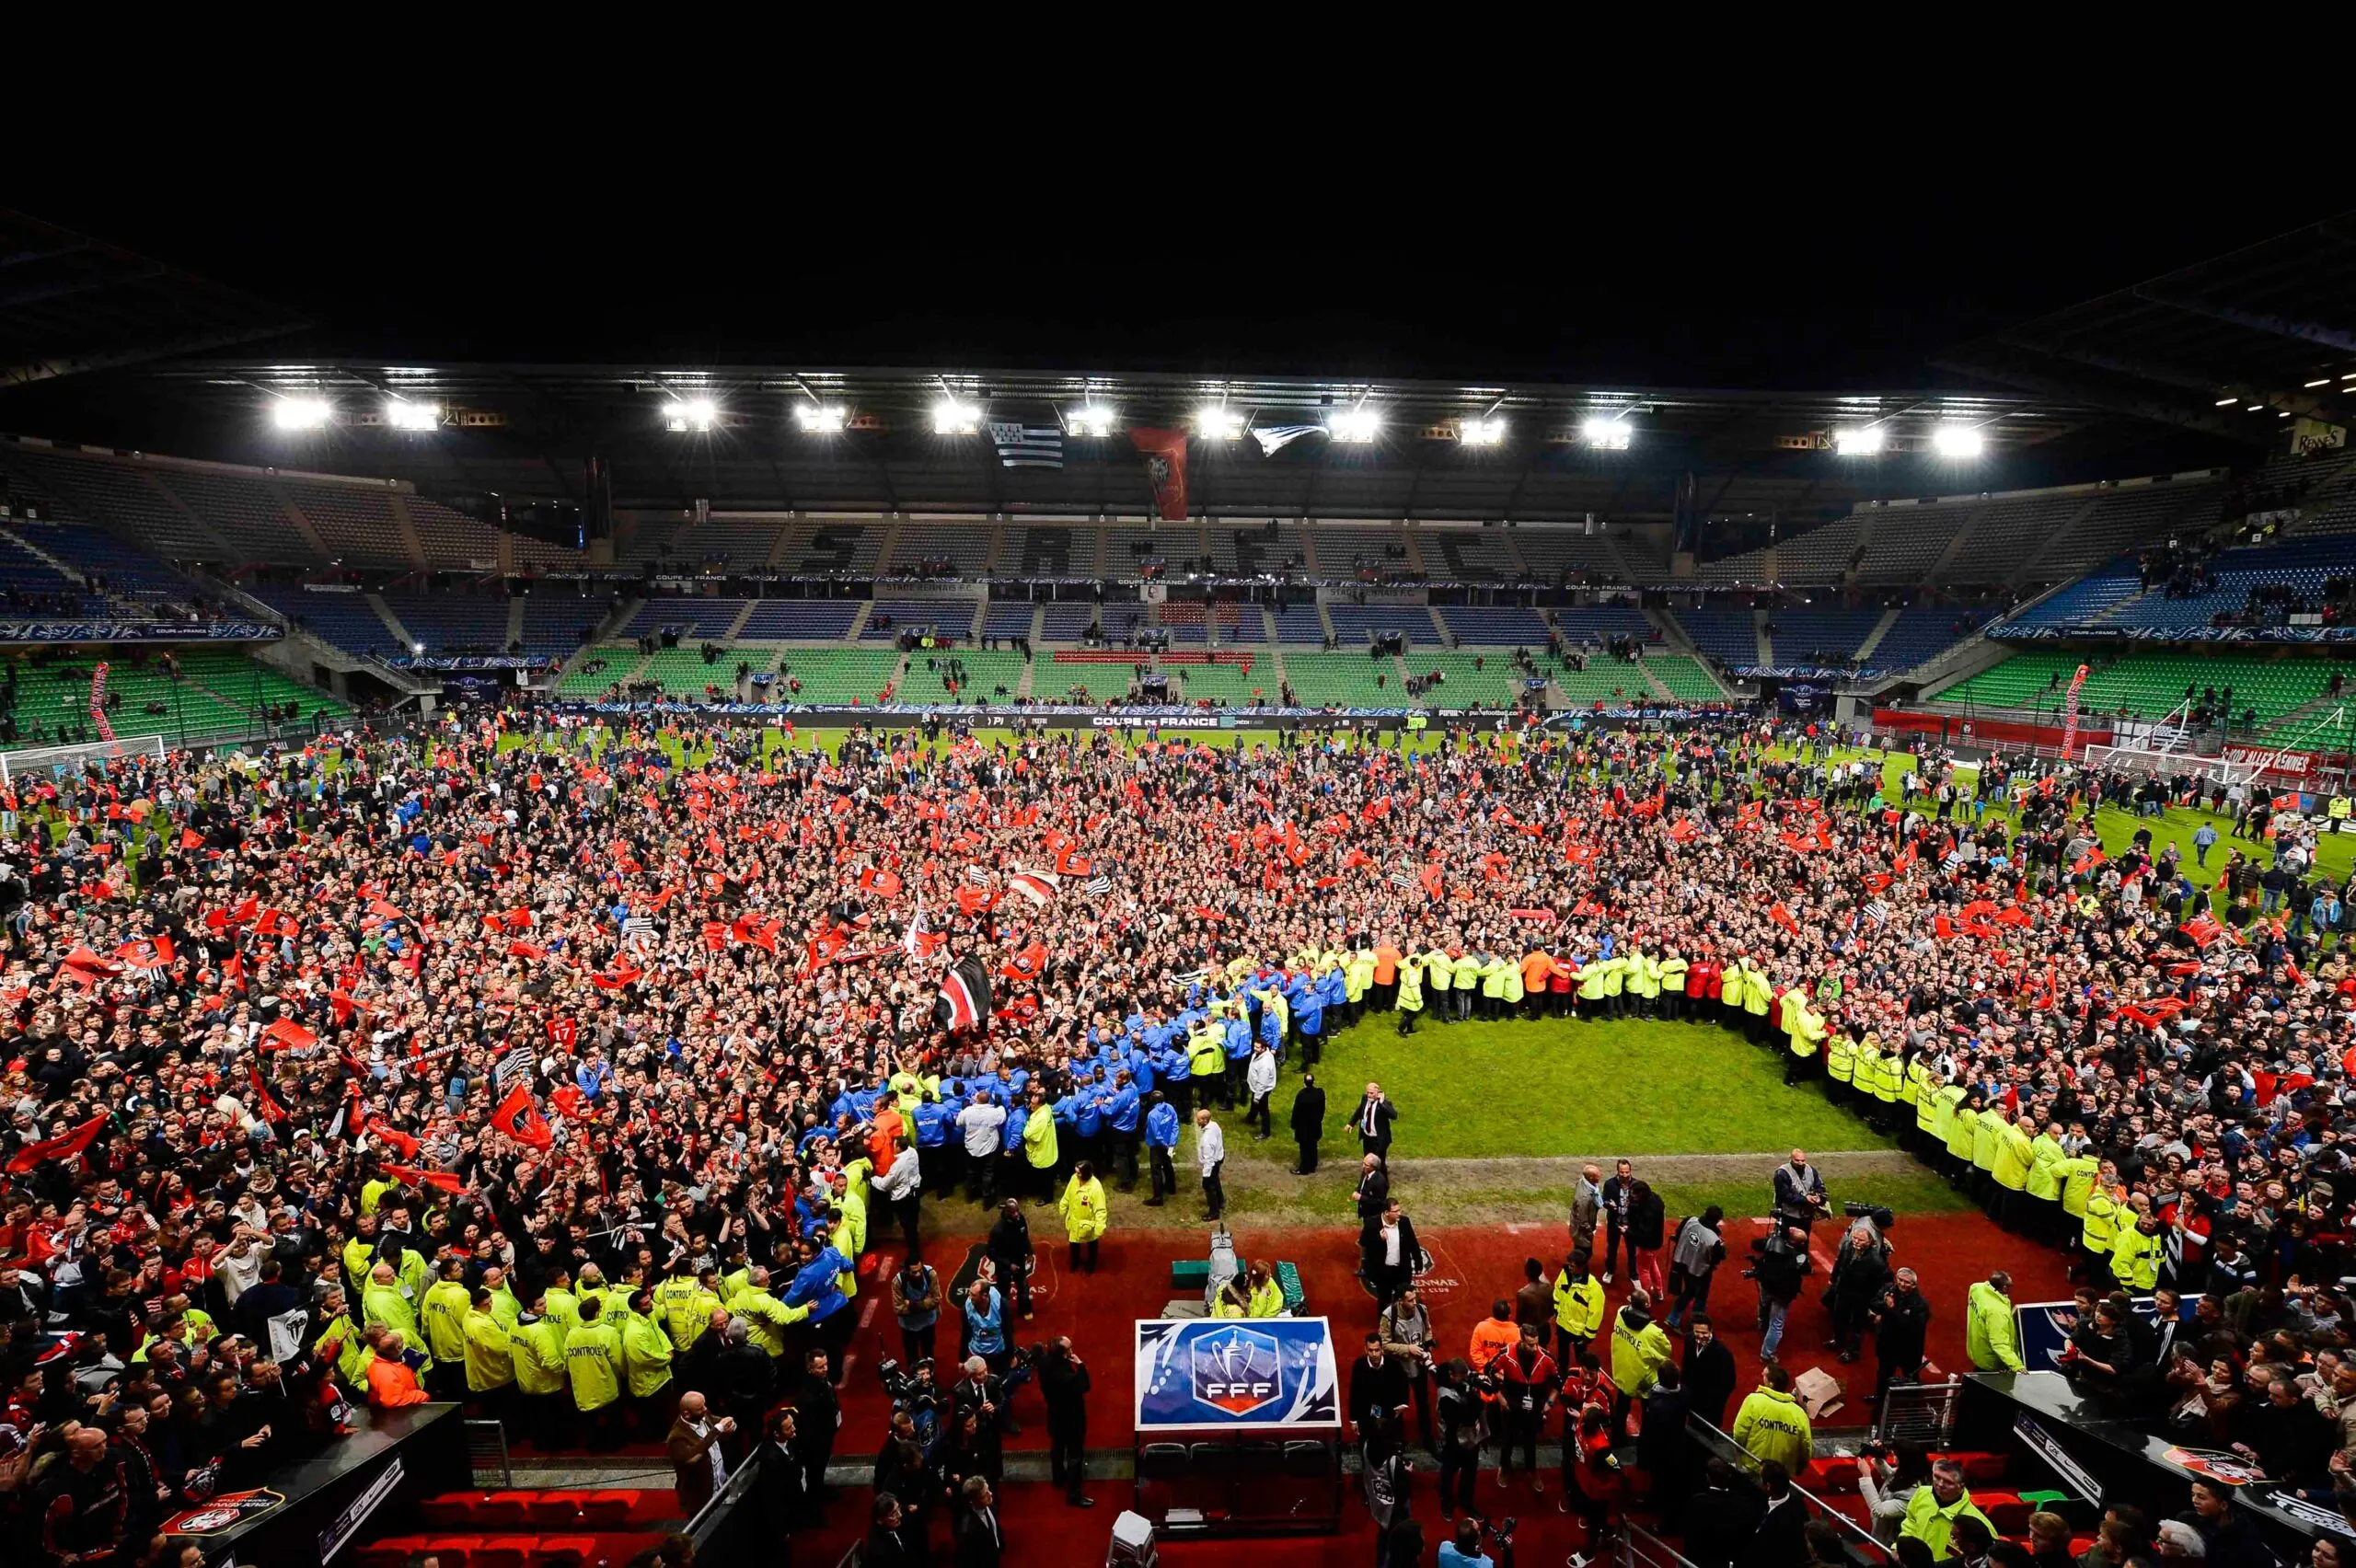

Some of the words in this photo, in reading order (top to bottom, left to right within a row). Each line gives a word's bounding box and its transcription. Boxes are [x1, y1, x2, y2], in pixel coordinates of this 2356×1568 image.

[1092, 717, 1142, 726] COUPE
[1160, 717, 1218, 727] FRANCE
[2229, 748, 2244, 763] KOP
[2272, 753, 2310, 772] RENNES
[553, 1027, 571, 1041] 17
[567, 1345, 603, 1358] CONTROLE
[1206, 1382, 1272, 1399] FFF
[1759, 1417, 1797, 1435] CONTROLE
